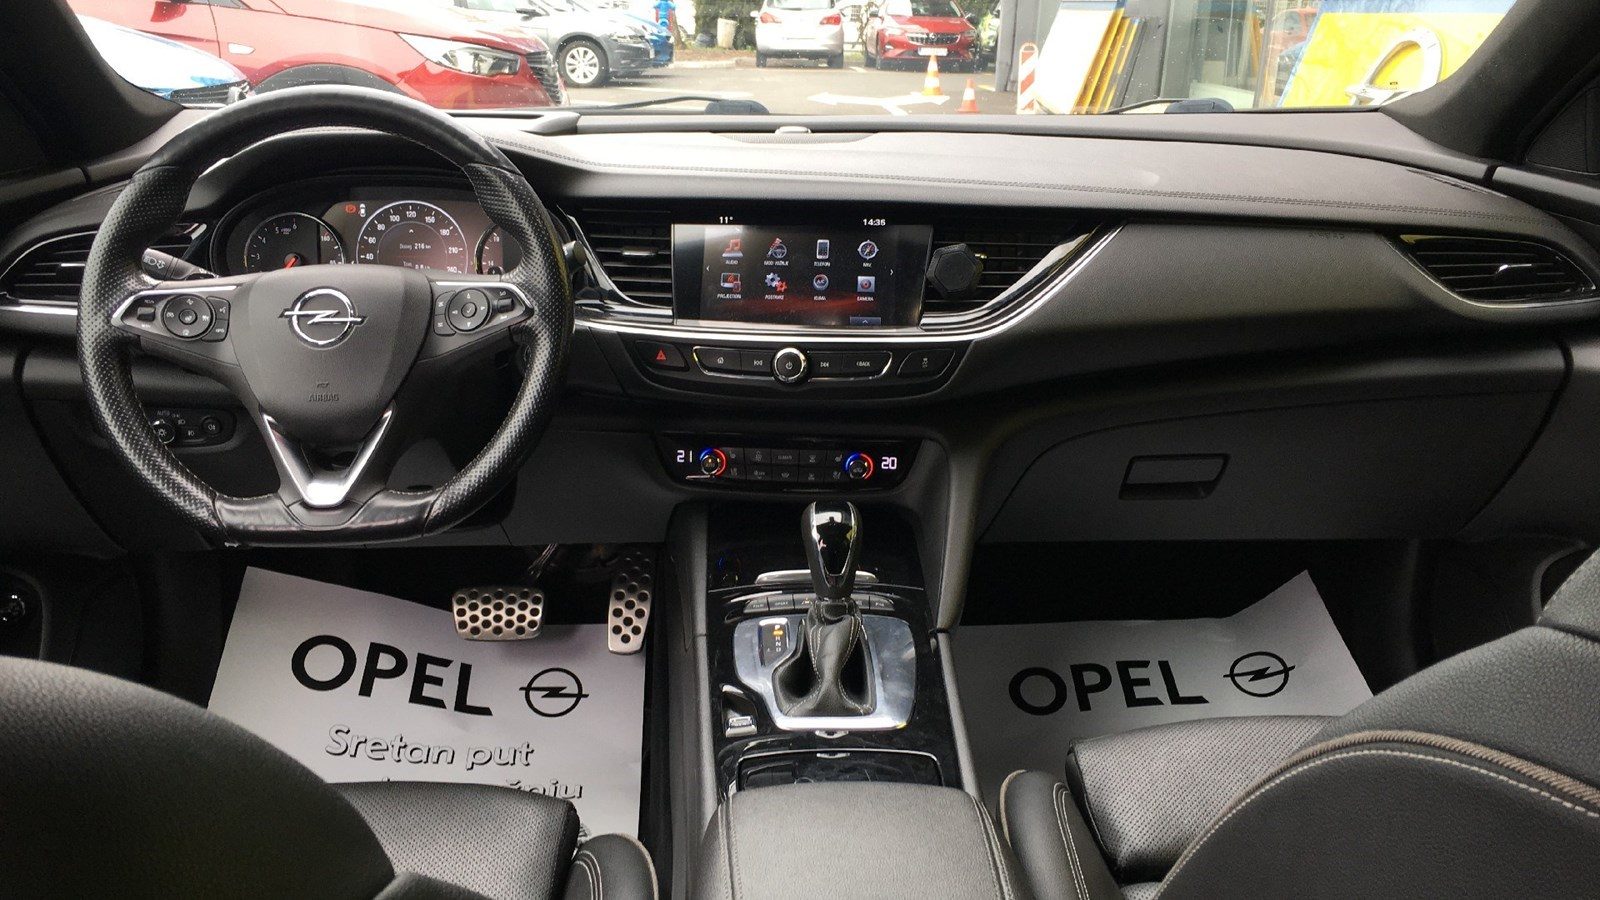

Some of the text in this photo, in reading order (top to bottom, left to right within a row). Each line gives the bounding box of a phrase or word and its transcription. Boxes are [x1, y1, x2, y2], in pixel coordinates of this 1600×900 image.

[275, 226, 280, 234] 5
[448, 246, 459, 254] 210
[308, 393, 340, 402] AIRBAG
[676, 449, 693, 463] 21
[881, 456, 898, 470] 20
[291, 634, 493, 717] OPEL
[1008, 659, 1210, 717] OPEL
[324, 723, 535, 771] Sretan put
